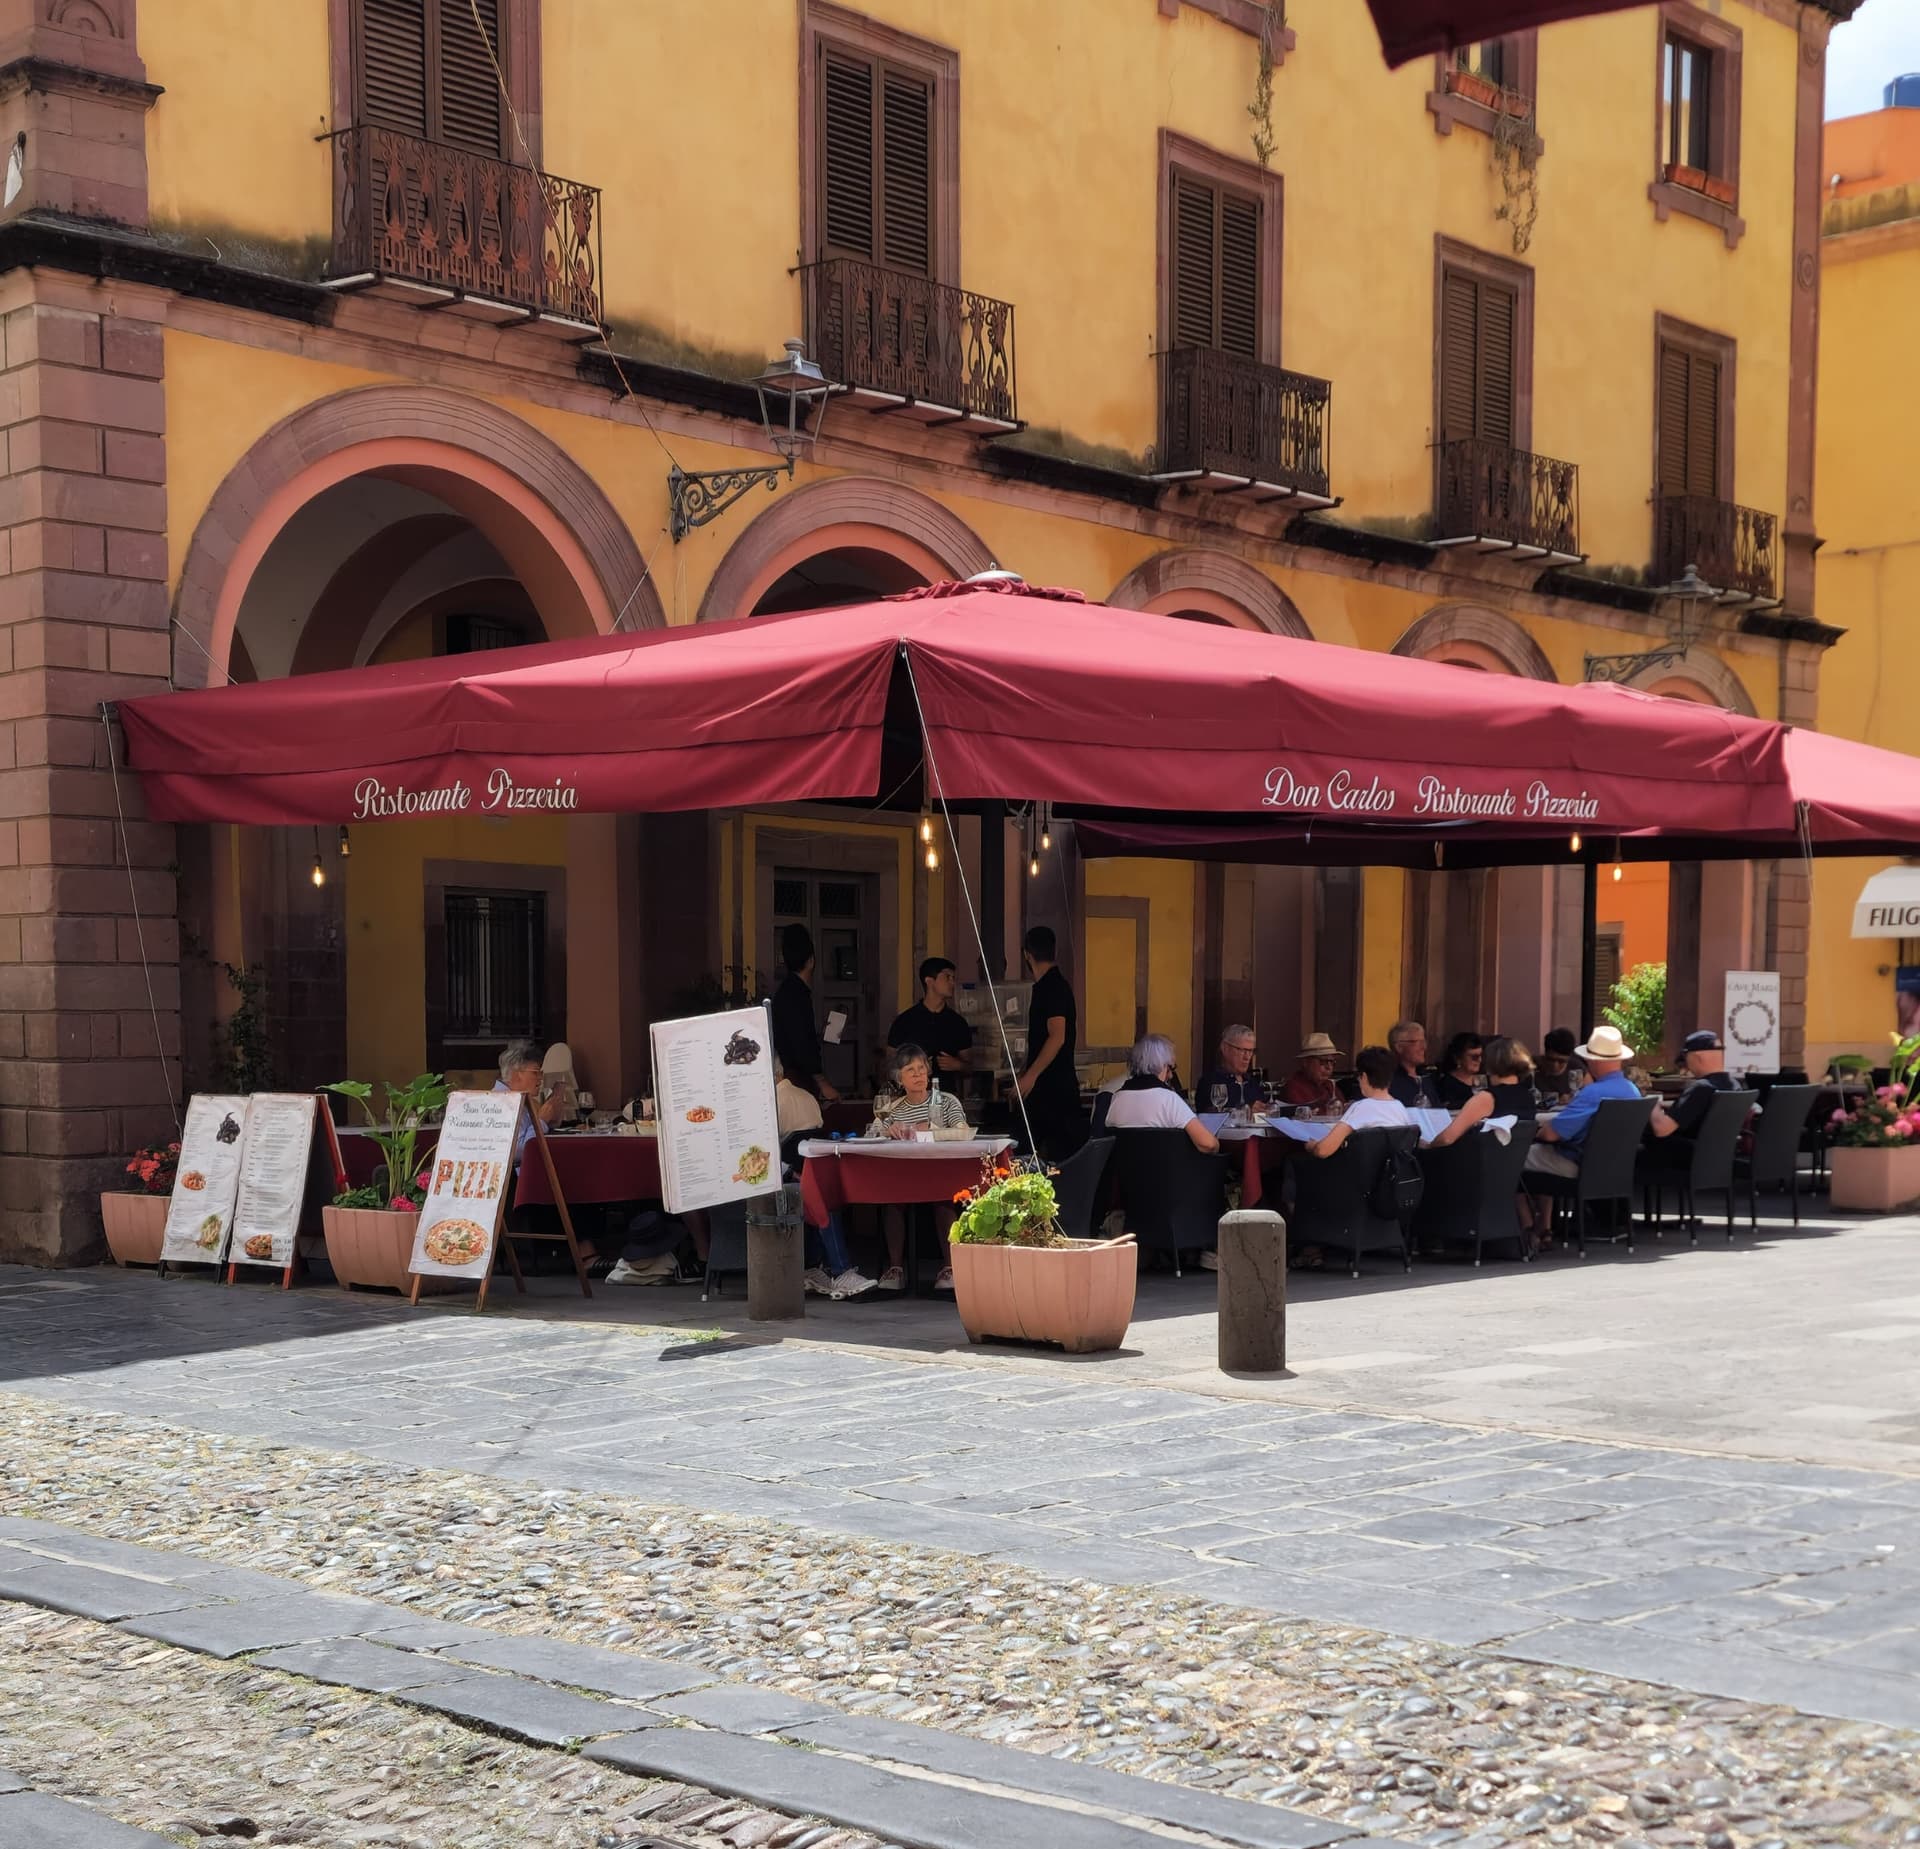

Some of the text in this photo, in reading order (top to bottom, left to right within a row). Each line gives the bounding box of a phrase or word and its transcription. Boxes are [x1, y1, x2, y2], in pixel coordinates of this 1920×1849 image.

[353, 768, 579, 820] Ristorante Pizzeria
[1262, 767, 1600, 819] Don Carlos Ristorante Pizzeria
[1869, 906, 1920, 927] FILIG
